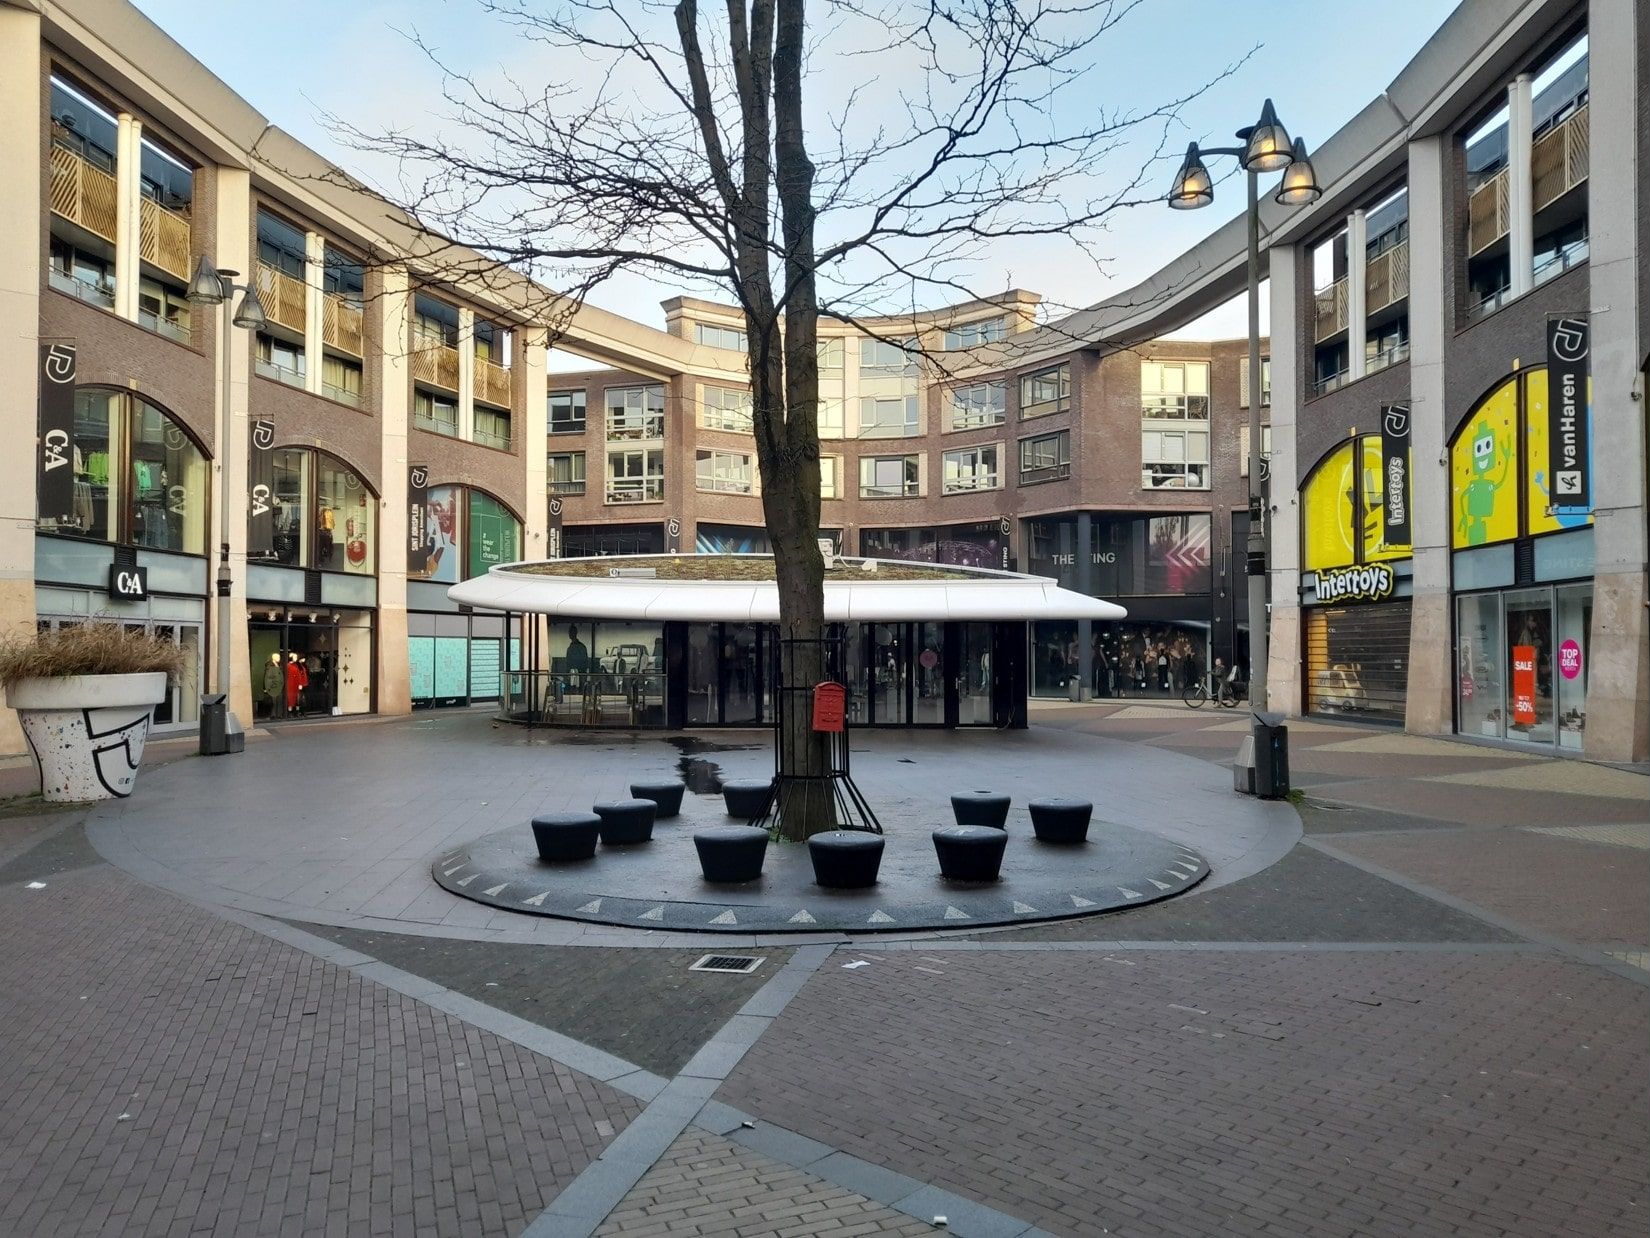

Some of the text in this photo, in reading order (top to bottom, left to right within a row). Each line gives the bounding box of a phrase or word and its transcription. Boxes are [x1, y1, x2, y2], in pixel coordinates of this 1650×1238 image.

[1560, 373, 1576, 468] vanHaren
[45, 428, 69, 472] C&A
[252, 484, 270, 517] C&A
[1387, 456, 1405, 526] Intertoys
[1052, 553, 1075, 565] THE
[117, 571, 143, 595] C&A
[1314, 565, 1390, 600] Intertoys
[1514, 660, 1533, 671] SALE
[1561, 648, 1579, 659] TOP
[1561, 658, 1579, 667] DEAL
[1515, 701, 1533, 712] -50%
